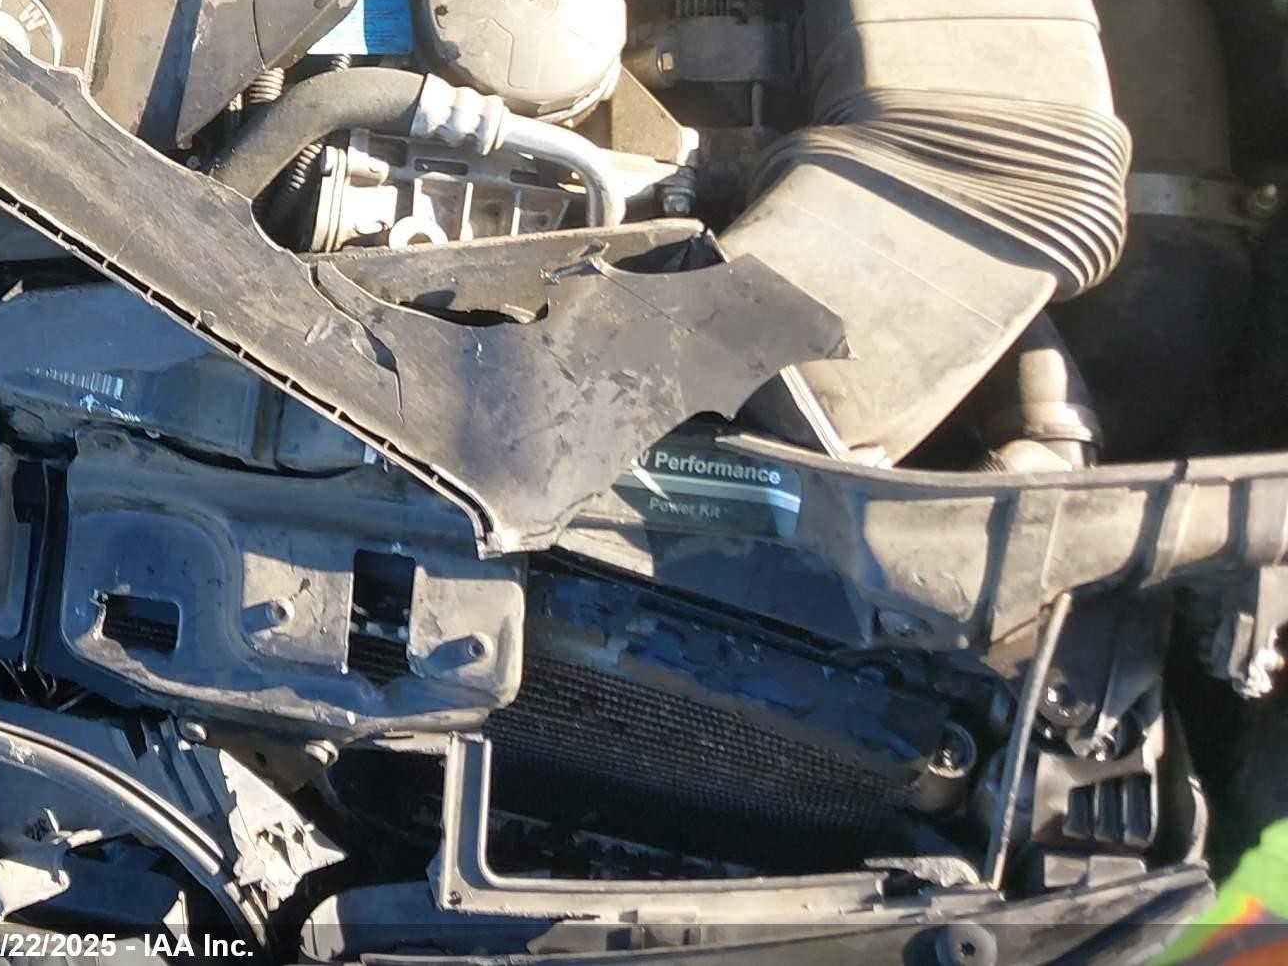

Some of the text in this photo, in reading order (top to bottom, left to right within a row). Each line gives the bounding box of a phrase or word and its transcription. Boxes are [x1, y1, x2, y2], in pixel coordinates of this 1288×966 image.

[655, 451, 781, 485] Performance
[650, 497, 721, 519] Power Kit
